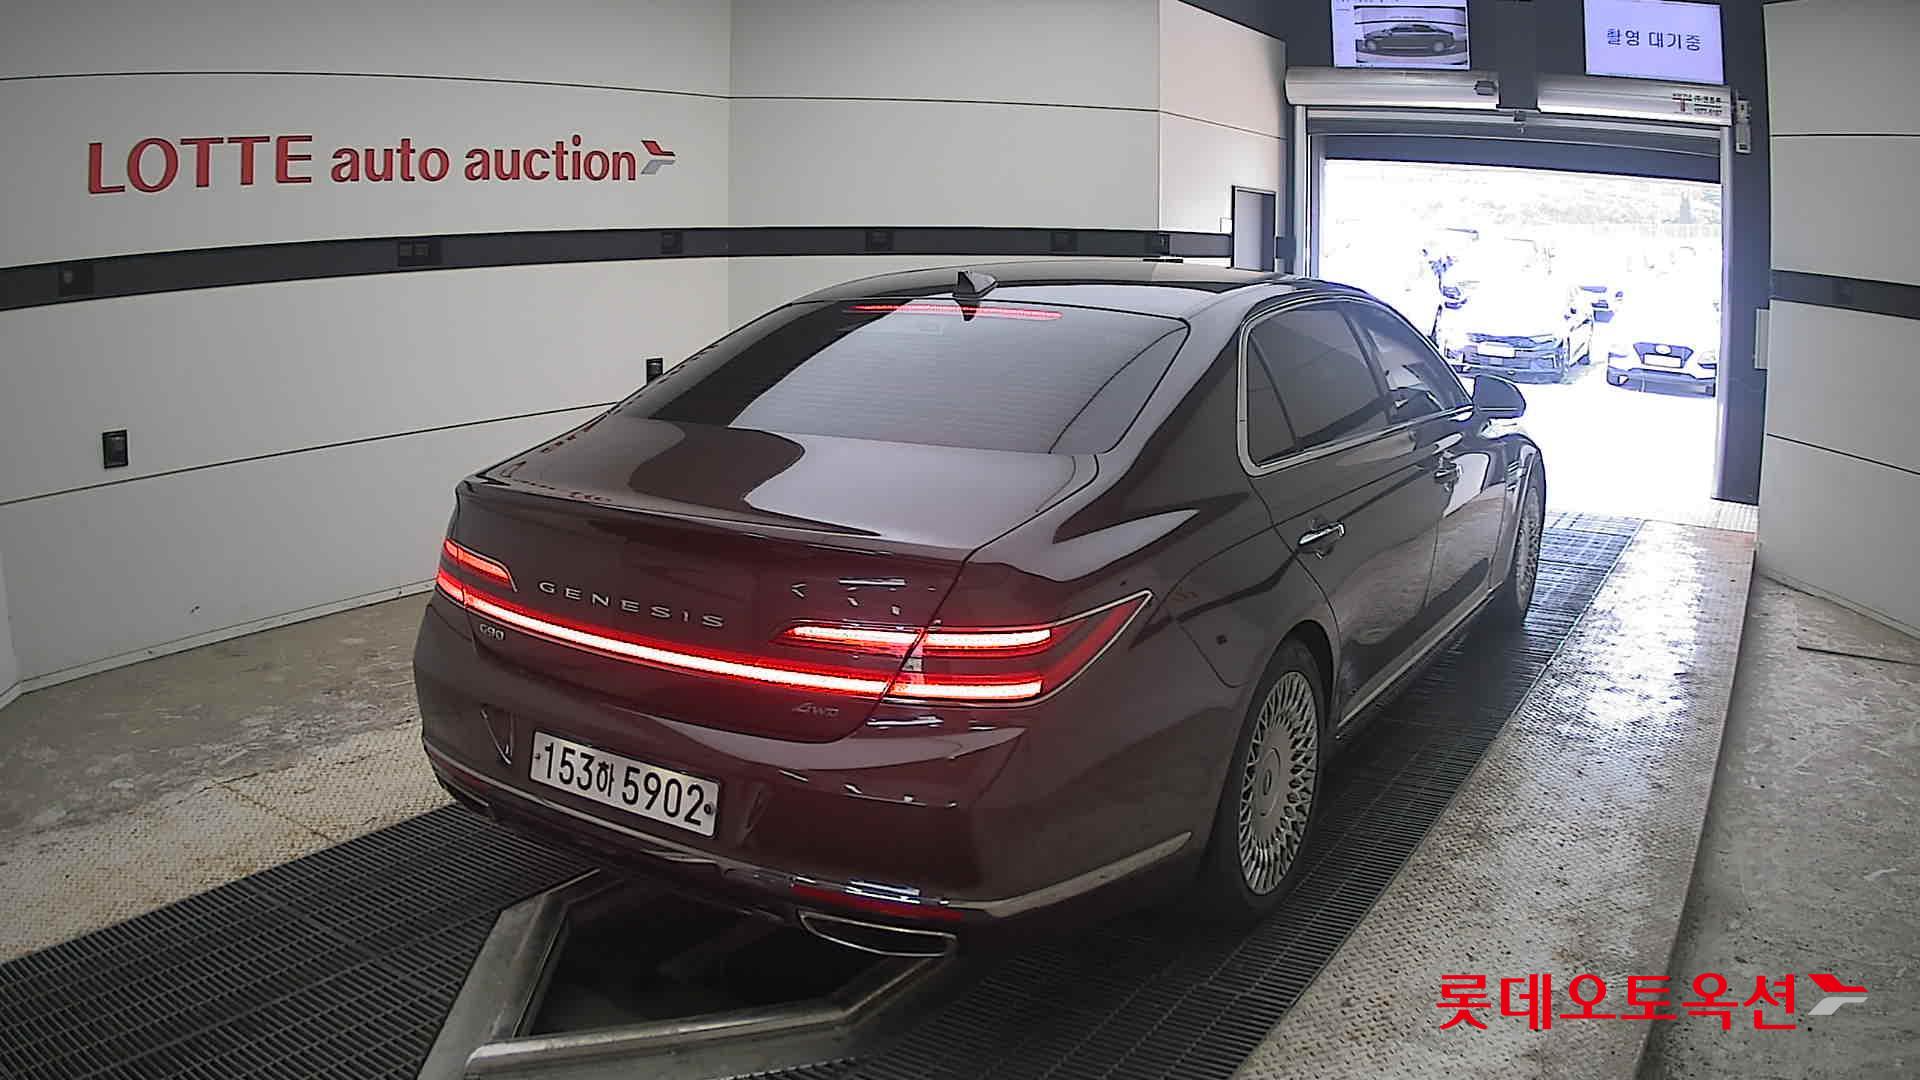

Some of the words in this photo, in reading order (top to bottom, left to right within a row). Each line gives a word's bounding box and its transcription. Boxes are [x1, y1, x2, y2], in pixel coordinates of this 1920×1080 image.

[1606, 28, 1640, 47] 촬영
[1648, 31, 1702, 52] 대기중
[87, 134, 313, 195] LOTTE
[330, 137, 450, 184] auto
[463, 134, 637, 183] auction
[538, 581, 725, 629] GENESIS
[479, 623, 505, 641] G90
[544, 742, 615, 798] 153하
[621, 765, 706, 827] 5902
